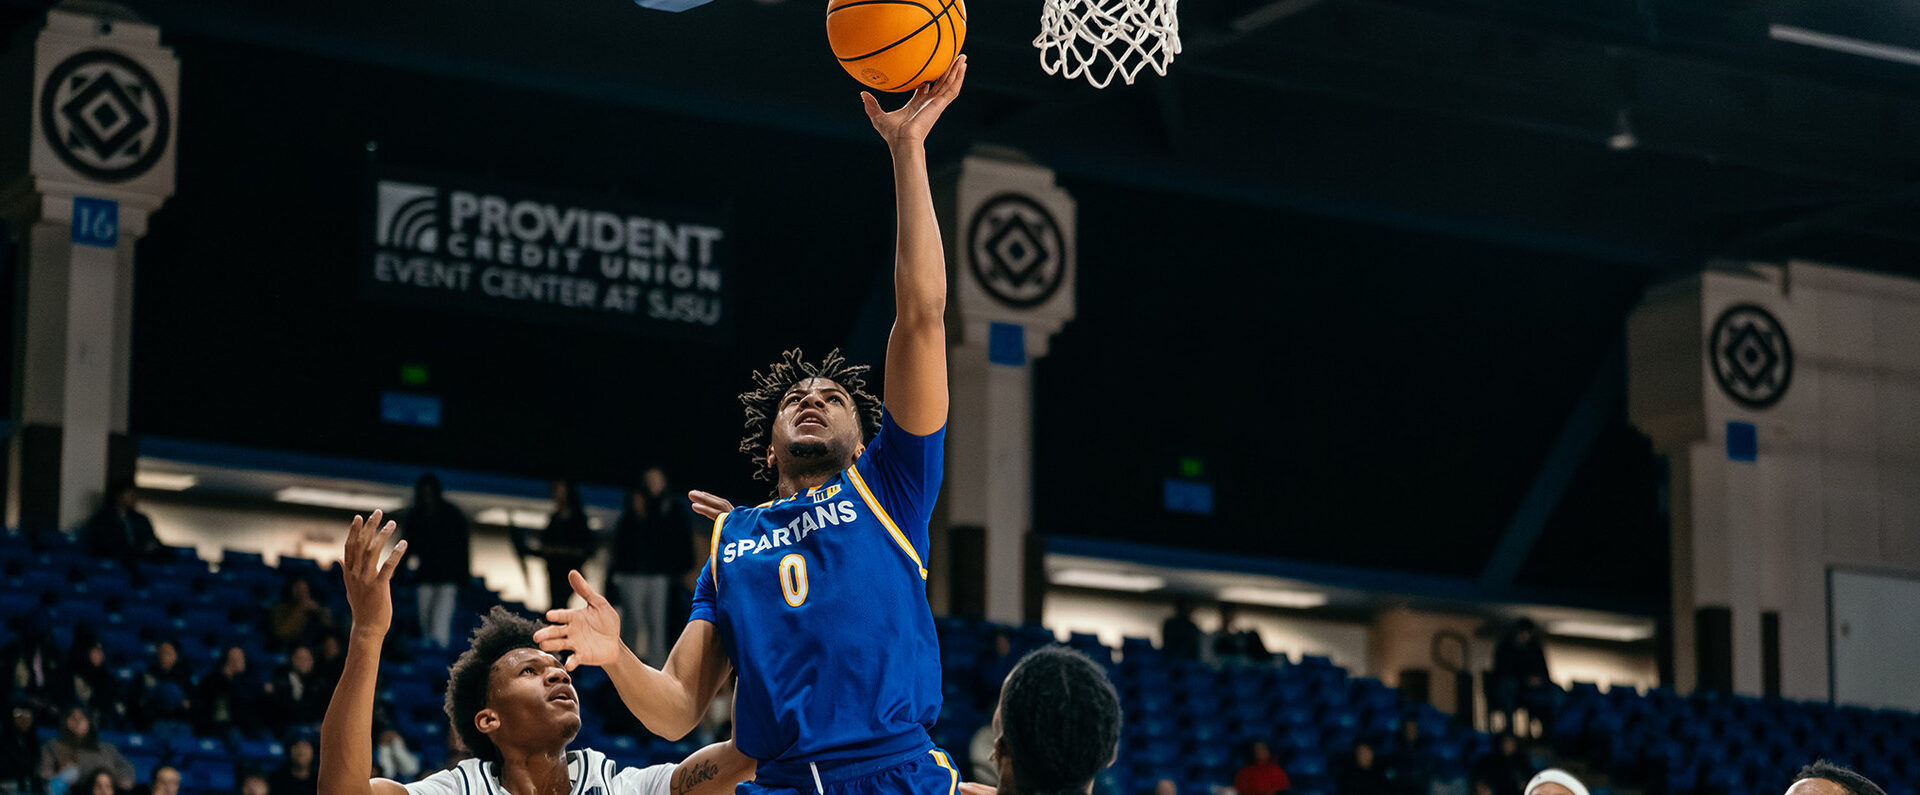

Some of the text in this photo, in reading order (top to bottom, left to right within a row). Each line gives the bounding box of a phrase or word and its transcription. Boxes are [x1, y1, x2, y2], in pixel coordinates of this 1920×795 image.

[81, 207, 114, 239] 16
[450, 191, 723, 264] PROVIDENT
[374, 253, 721, 325] EVENT CENTER AT SJSU
[448, 233, 721, 291] CREDIT UNION
[723, 501, 857, 563] SPARTANS
[779, 554, 808, 607] 0
